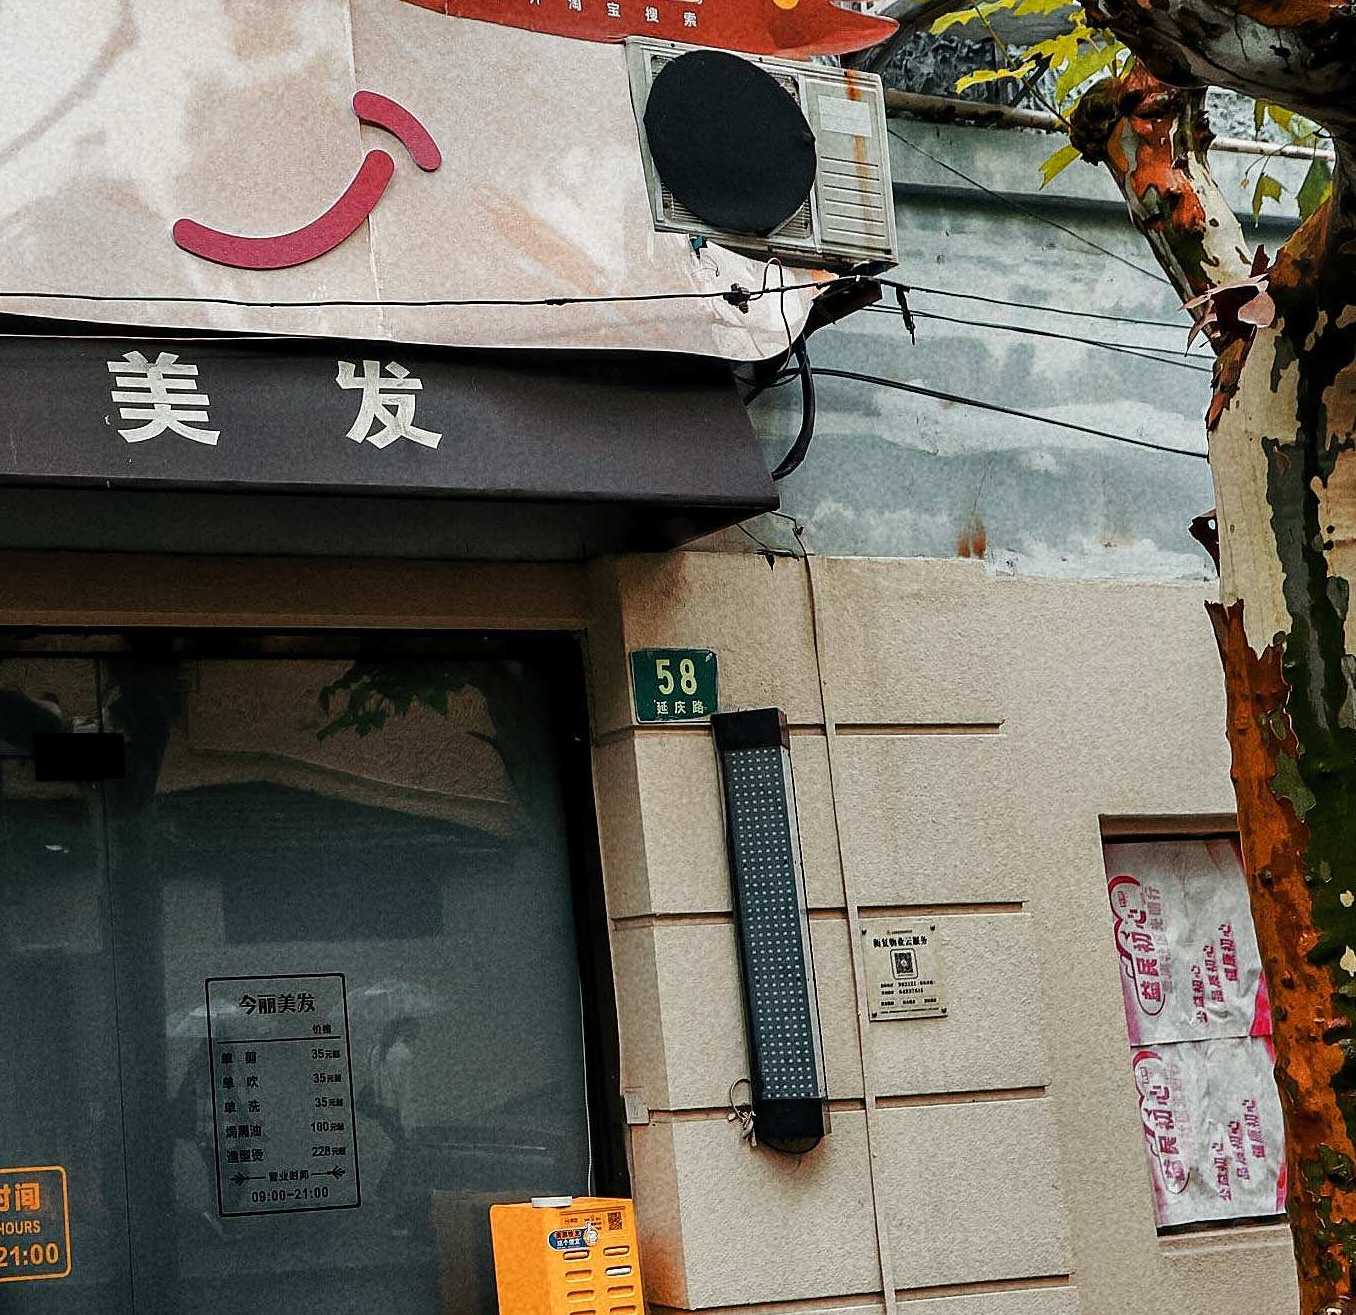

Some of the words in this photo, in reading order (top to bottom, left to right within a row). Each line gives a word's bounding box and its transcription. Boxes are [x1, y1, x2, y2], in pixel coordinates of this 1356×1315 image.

[655, 658, 698, 696] 58
[656, 700, 705, 715] 延庆路
[239, 992, 316, 1016] 今丽美发
[251, 1186, 329, 1203] 09:00-21:00
